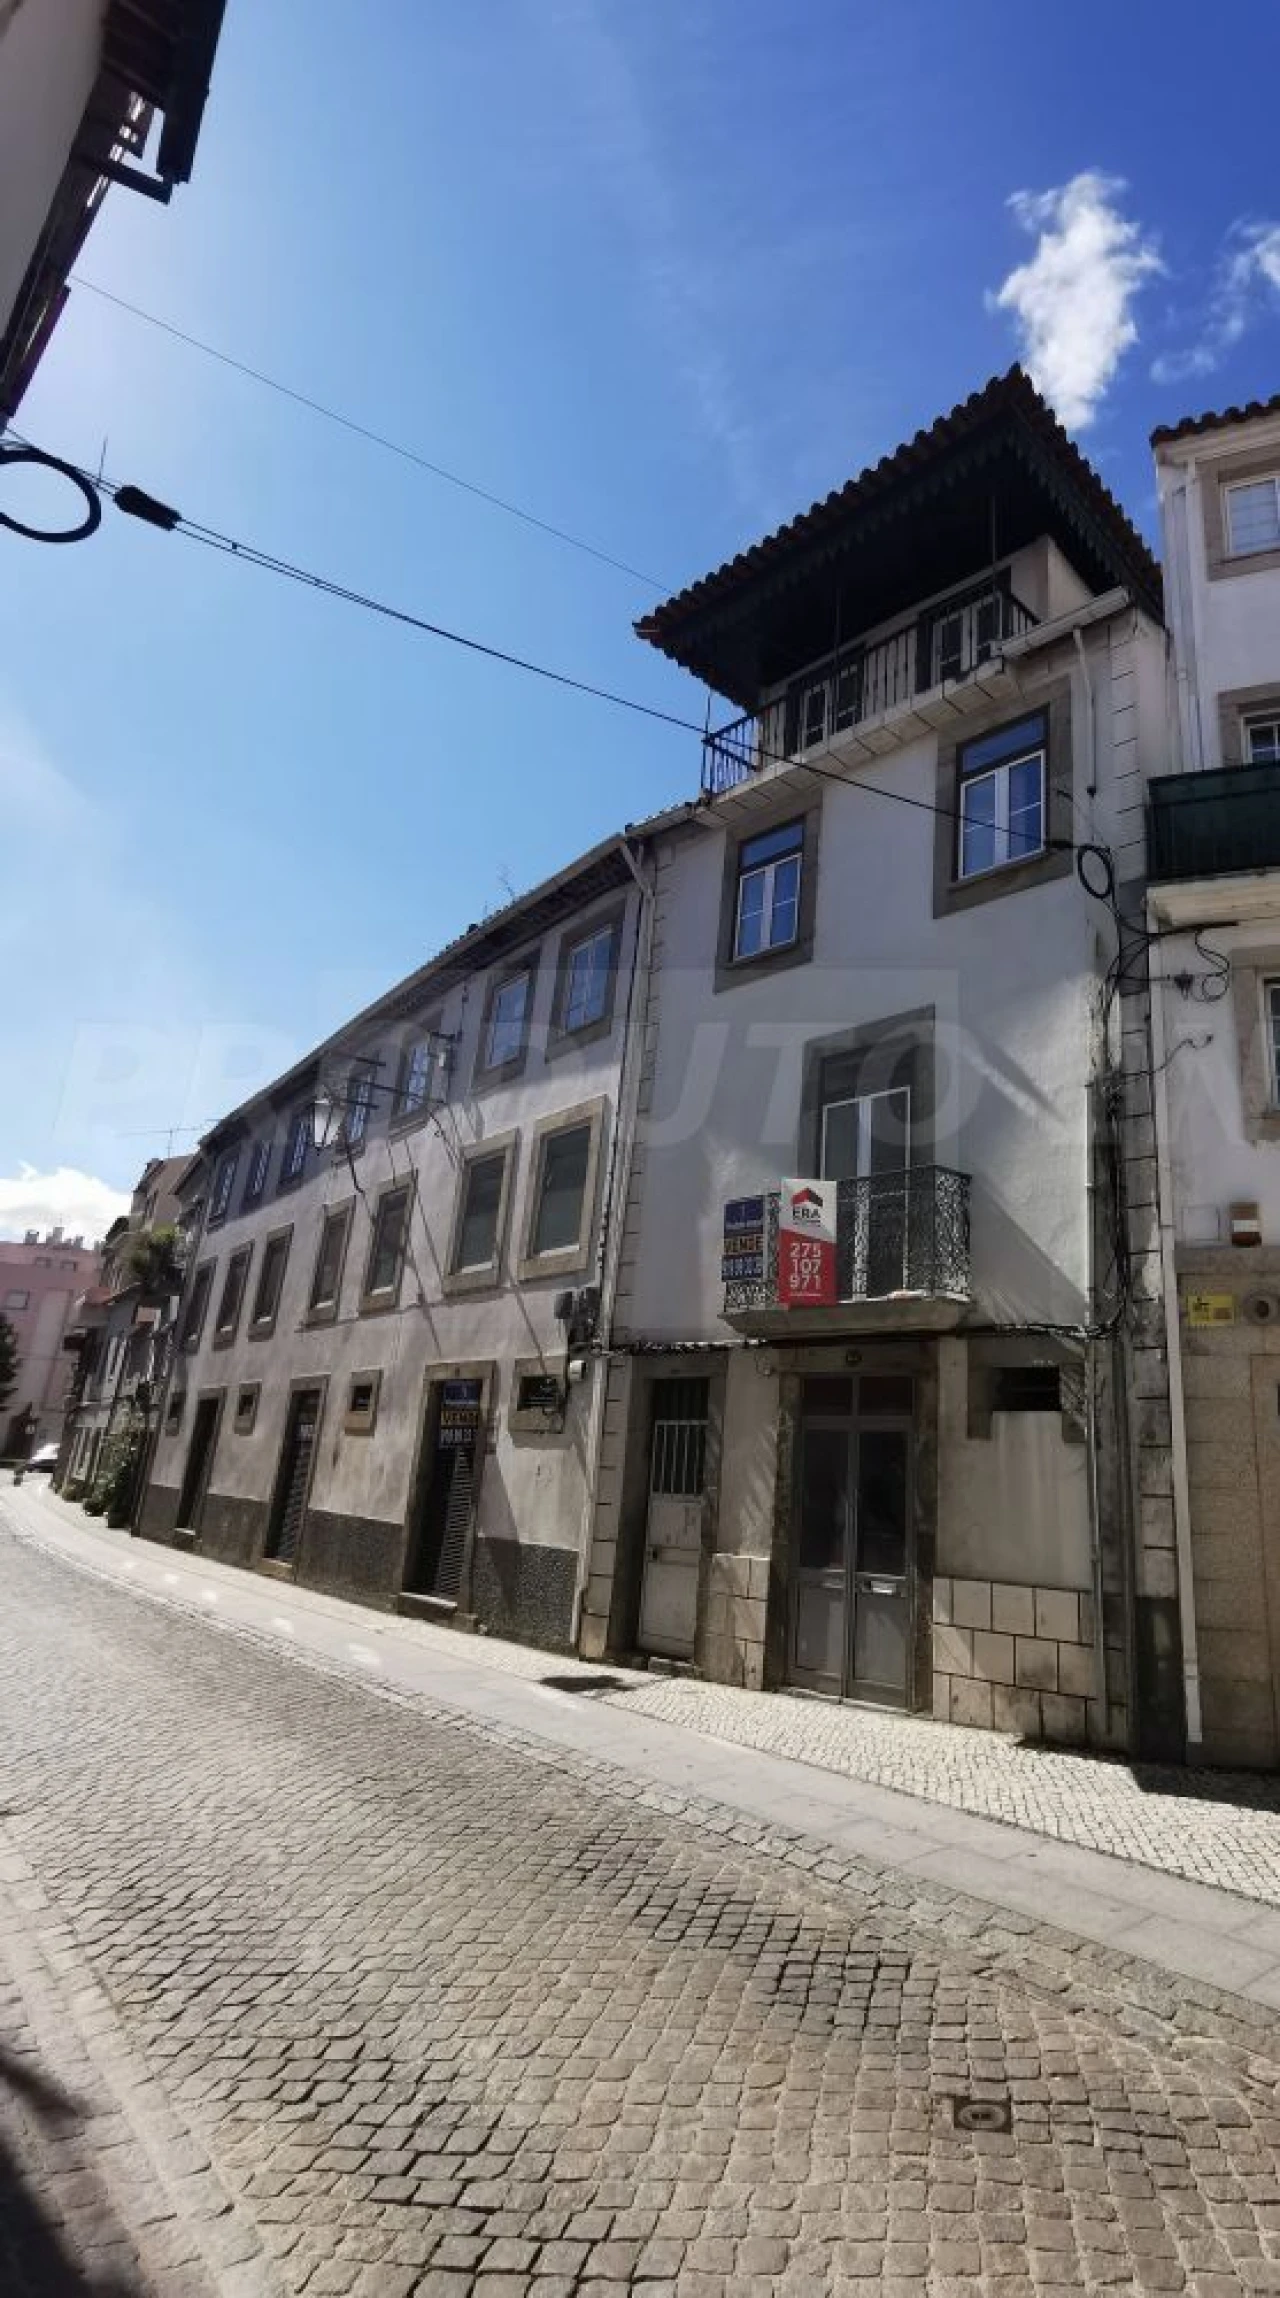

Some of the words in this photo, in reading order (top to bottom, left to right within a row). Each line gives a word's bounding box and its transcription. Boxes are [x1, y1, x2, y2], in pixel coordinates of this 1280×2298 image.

[792, 1207, 821, 1220] ERA
[790, 1242, 821, 1258] 275
[792, 1258, 821, 1274] 107
[790, 1273, 821, 1290] 971
